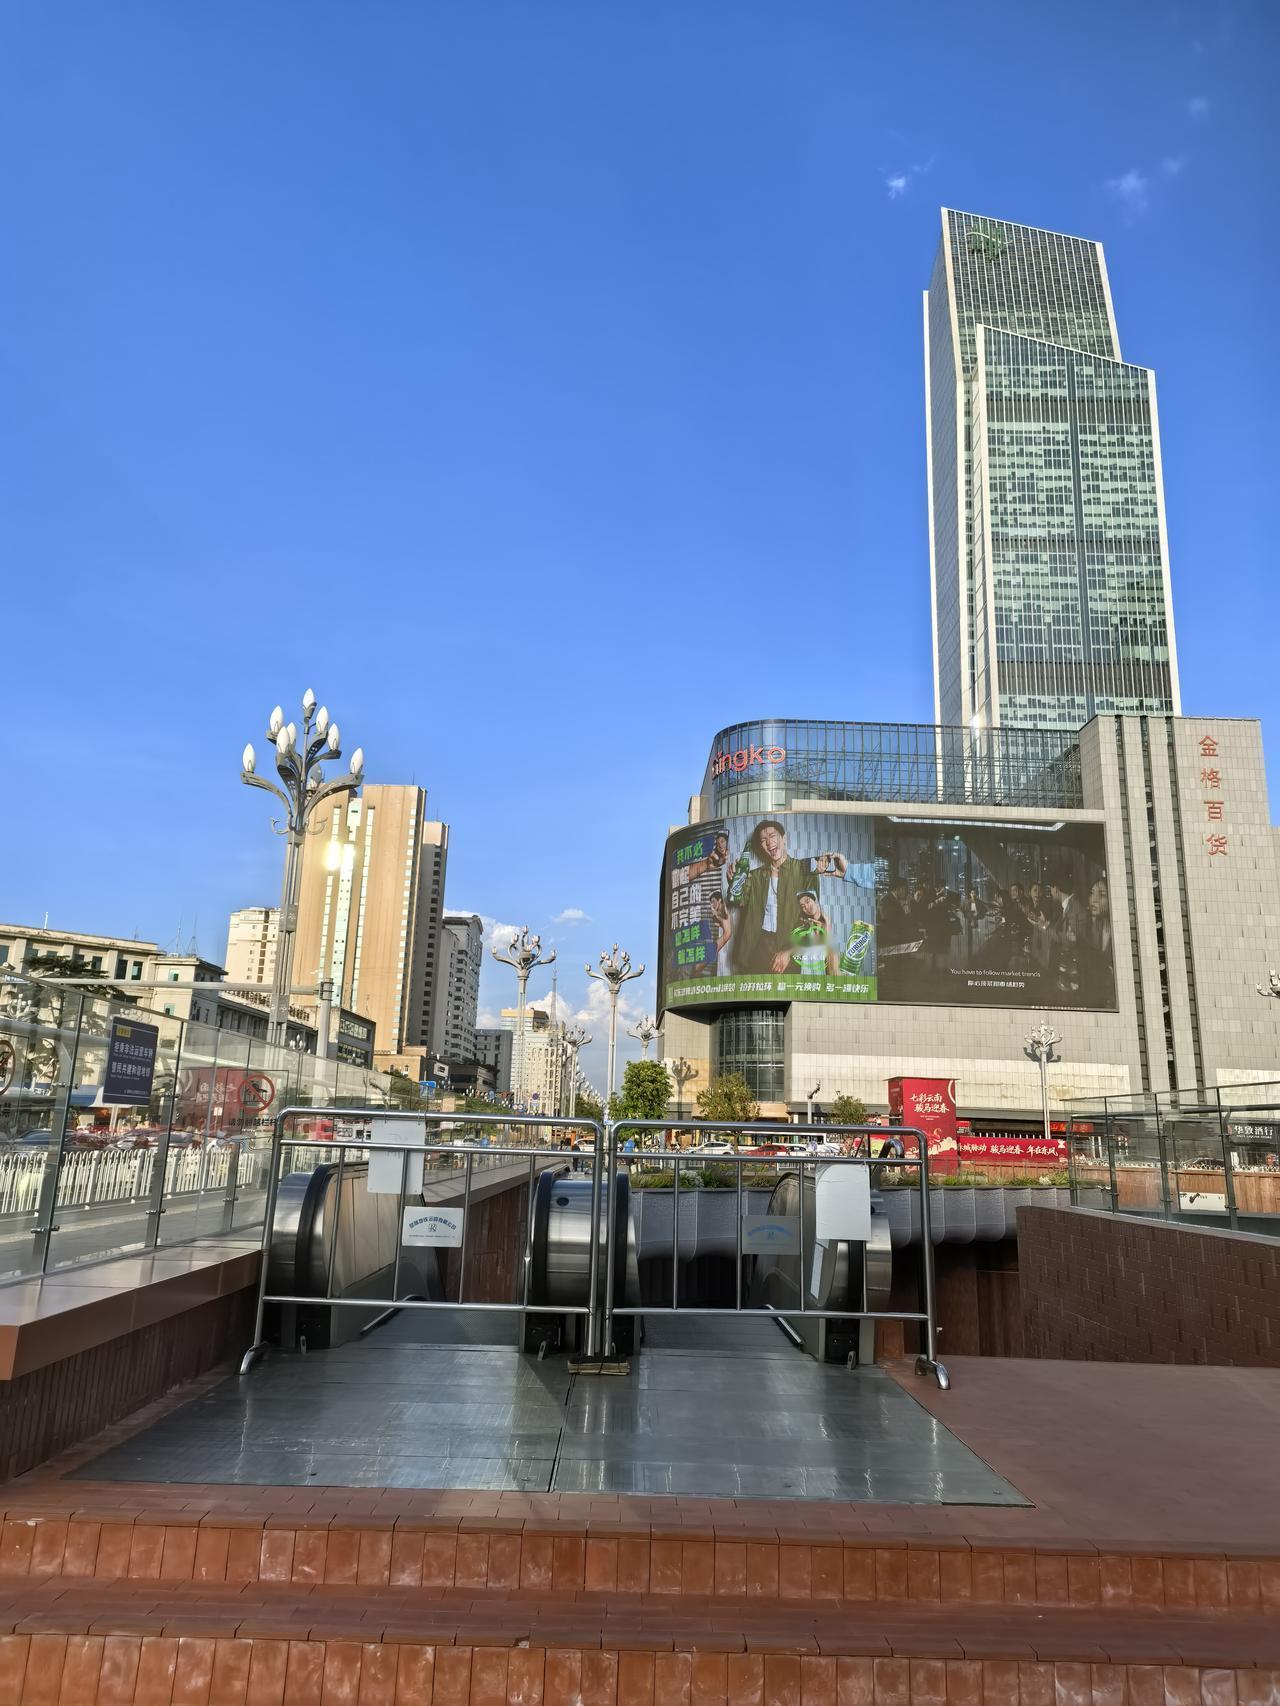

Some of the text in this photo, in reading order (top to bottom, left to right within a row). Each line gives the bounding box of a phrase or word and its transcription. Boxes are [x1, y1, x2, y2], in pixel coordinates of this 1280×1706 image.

[1199, 735, 1228, 856] 金格百货
[672, 883, 701, 909] 自己的
[672, 905, 701, 929] 不完美
[910, 1092, 943, 1103] 七彩云南
[913, 1102, 950, 1114] 骏马迎春
[1234, 1125, 1273, 1136] 华致酒行
[989, 1144, 1025, 1155] 骏马迎春
